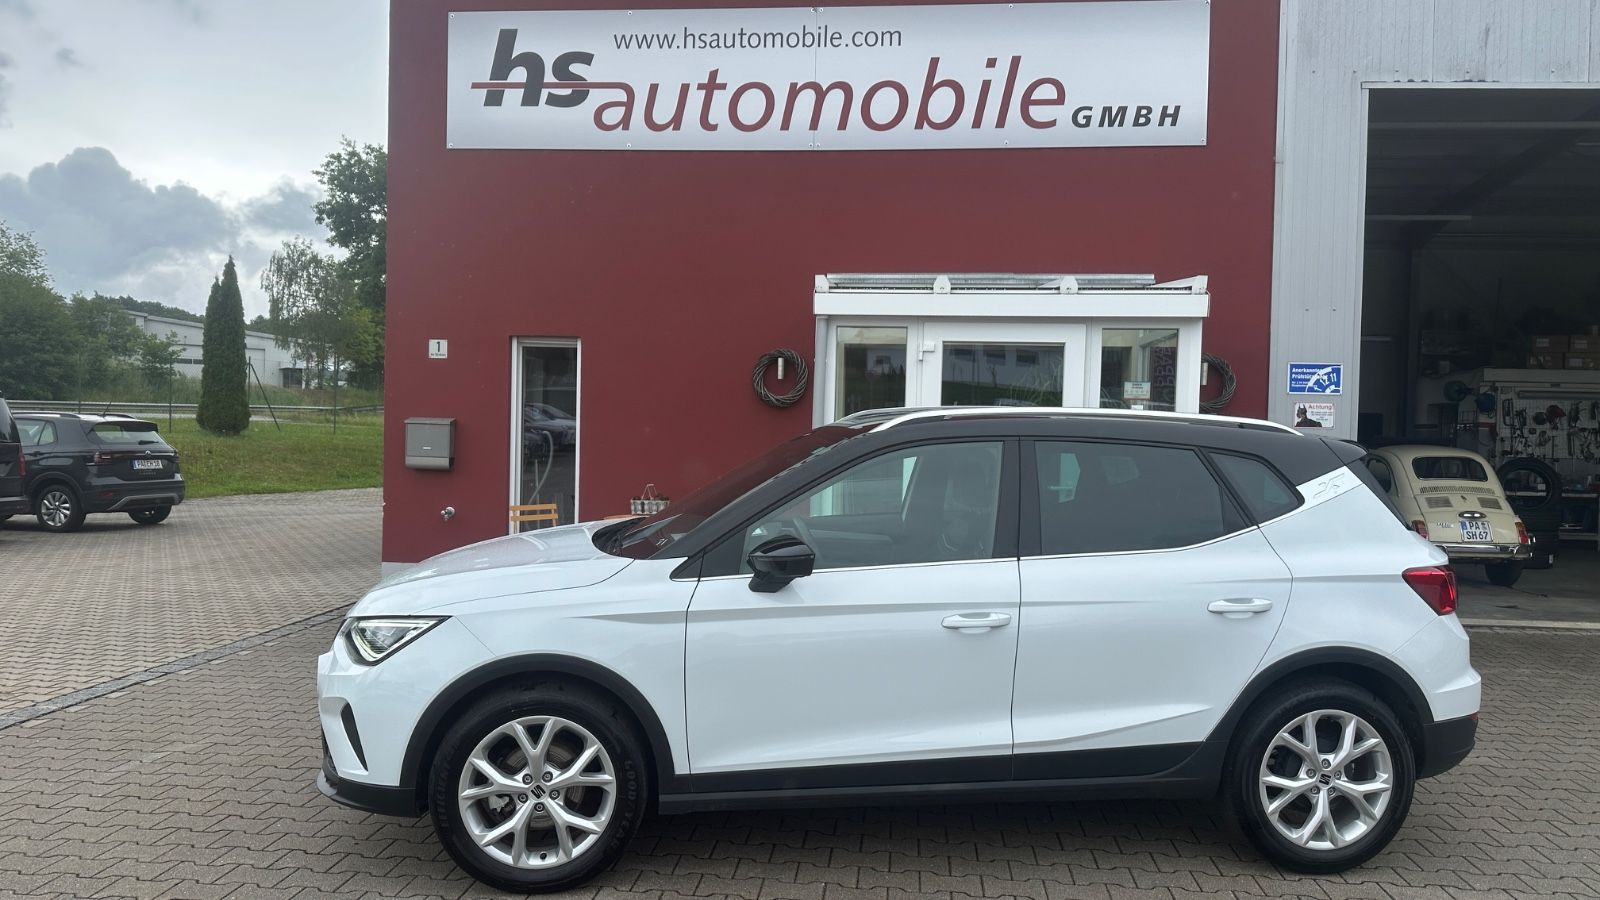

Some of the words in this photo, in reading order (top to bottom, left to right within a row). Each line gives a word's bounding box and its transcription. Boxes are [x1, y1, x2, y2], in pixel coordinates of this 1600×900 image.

[613, 25, 902, 50] www.hsautomobile.com
[483, 28, 595, 108] hs
[593, 56, 1066, 132] automobile
[1071, 105, 1181, 129] GMBH
[436, 341, 441, 352] 1
[1468, 521, 1481, 530] PA
[1466, 531, 1478, 540] SH
[1478, 531, 1488, 540] 67
